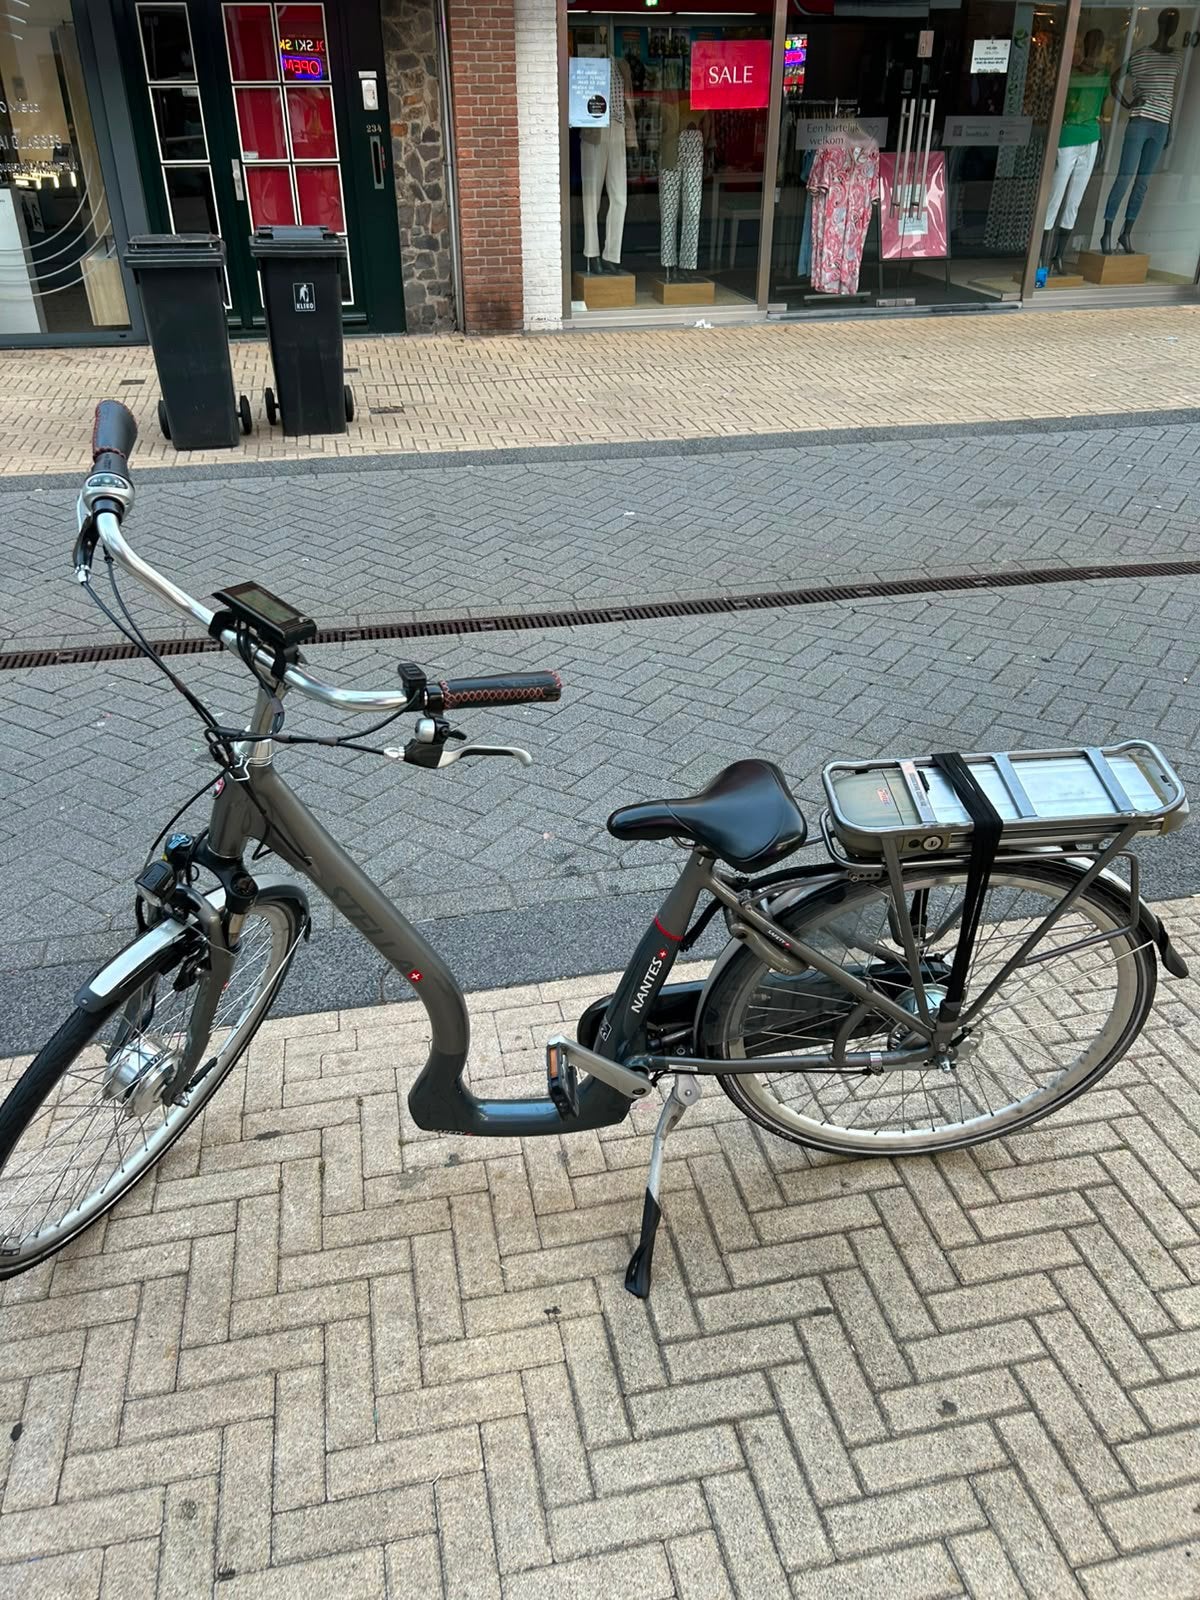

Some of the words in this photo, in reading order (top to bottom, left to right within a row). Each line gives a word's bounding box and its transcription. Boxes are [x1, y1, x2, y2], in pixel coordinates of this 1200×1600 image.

[708, 65, 754, 84] SALE
[366, 124, 382, 134] 234
[806, 123, 823, 133] Een
[825, 121, 860, 134] hartelijk
[809, 135, 844, 146] welkom
[331, 885, 416, 976] STELLA
[631, 956, 663, 1014] NANTES
